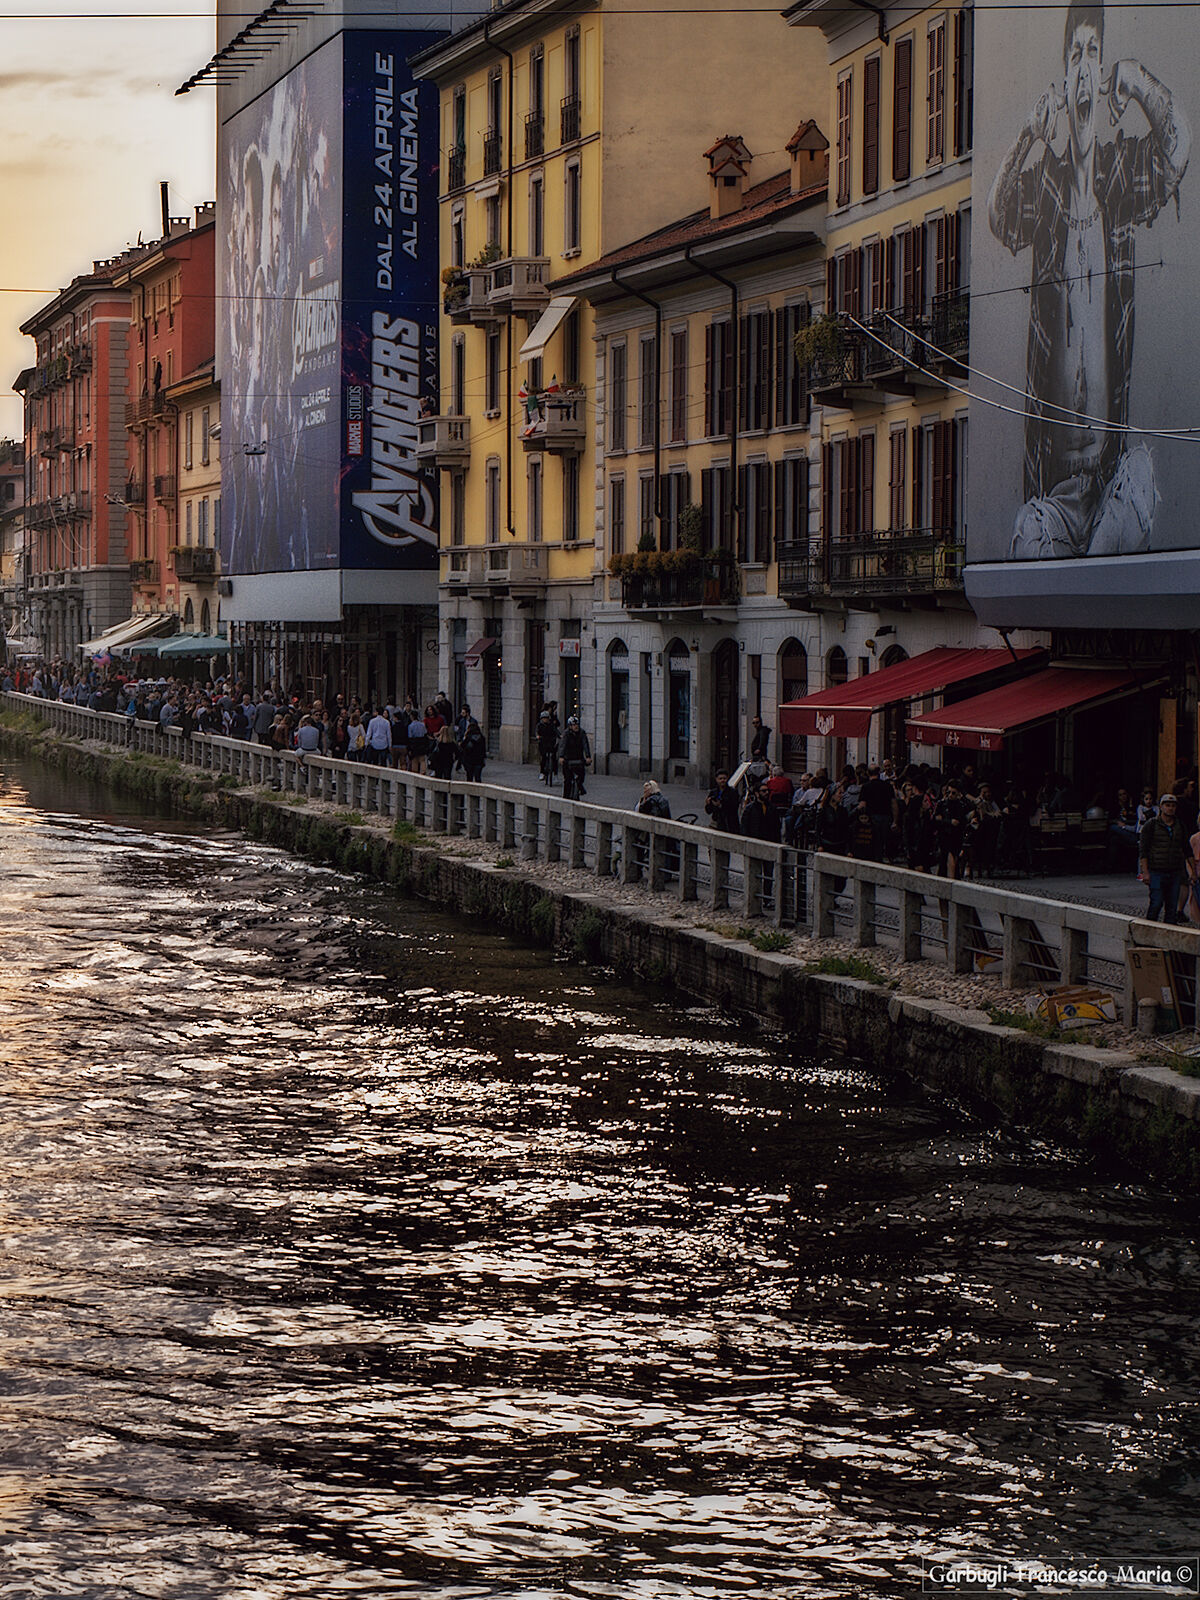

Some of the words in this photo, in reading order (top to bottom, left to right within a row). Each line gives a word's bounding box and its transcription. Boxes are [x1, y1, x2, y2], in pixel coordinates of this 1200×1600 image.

[374, 52, 394, 178] APRILE
[400, 87, 419, 215] CINEMA
[374, 182, 393, 228] 24
[377, 233, 393, 291] DAL
[402, 221, 418, 260] AL
[304, 351, 337, 374] ENDGAME
[349, 386, 362, 420] STUDIOS
[348, 421, 362, 455] MARVEL
[351, 310, 439, 548] AVENGERS
